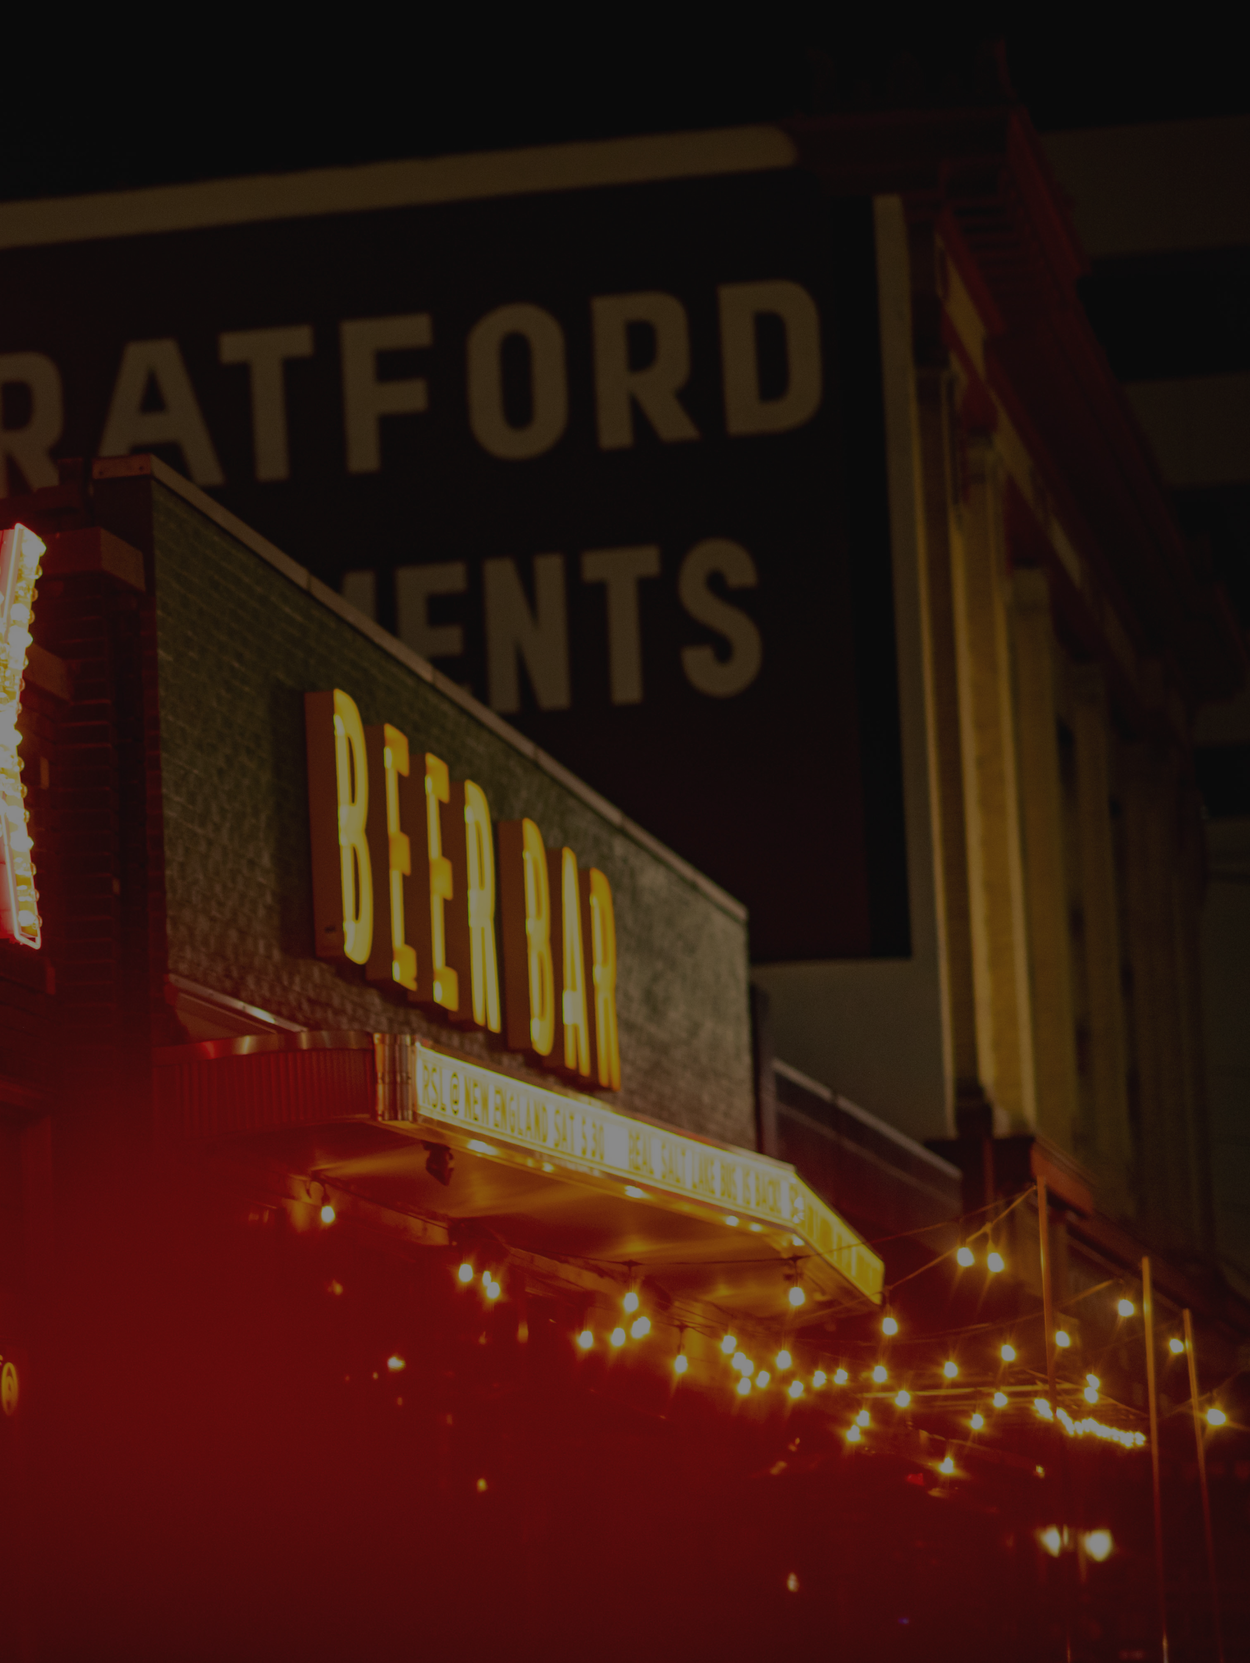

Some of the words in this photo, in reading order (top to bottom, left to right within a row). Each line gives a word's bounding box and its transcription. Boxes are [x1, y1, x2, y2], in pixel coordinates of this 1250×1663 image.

[342, 536, 763, 715] ENTS
[333, 687, 501, 1033] BEER
[522, 817, 621, 1092] BAR
[421, 1060, 446, 1113] RSL
[449, 1070, 459, 1117] @
[464, 1075, 488, 1126] NEW
[494, 1085, 547, 1144] ENGLAND
[554, 1105, 573, 1153] SAT
[661, 1141, 685, 1185] SALT
